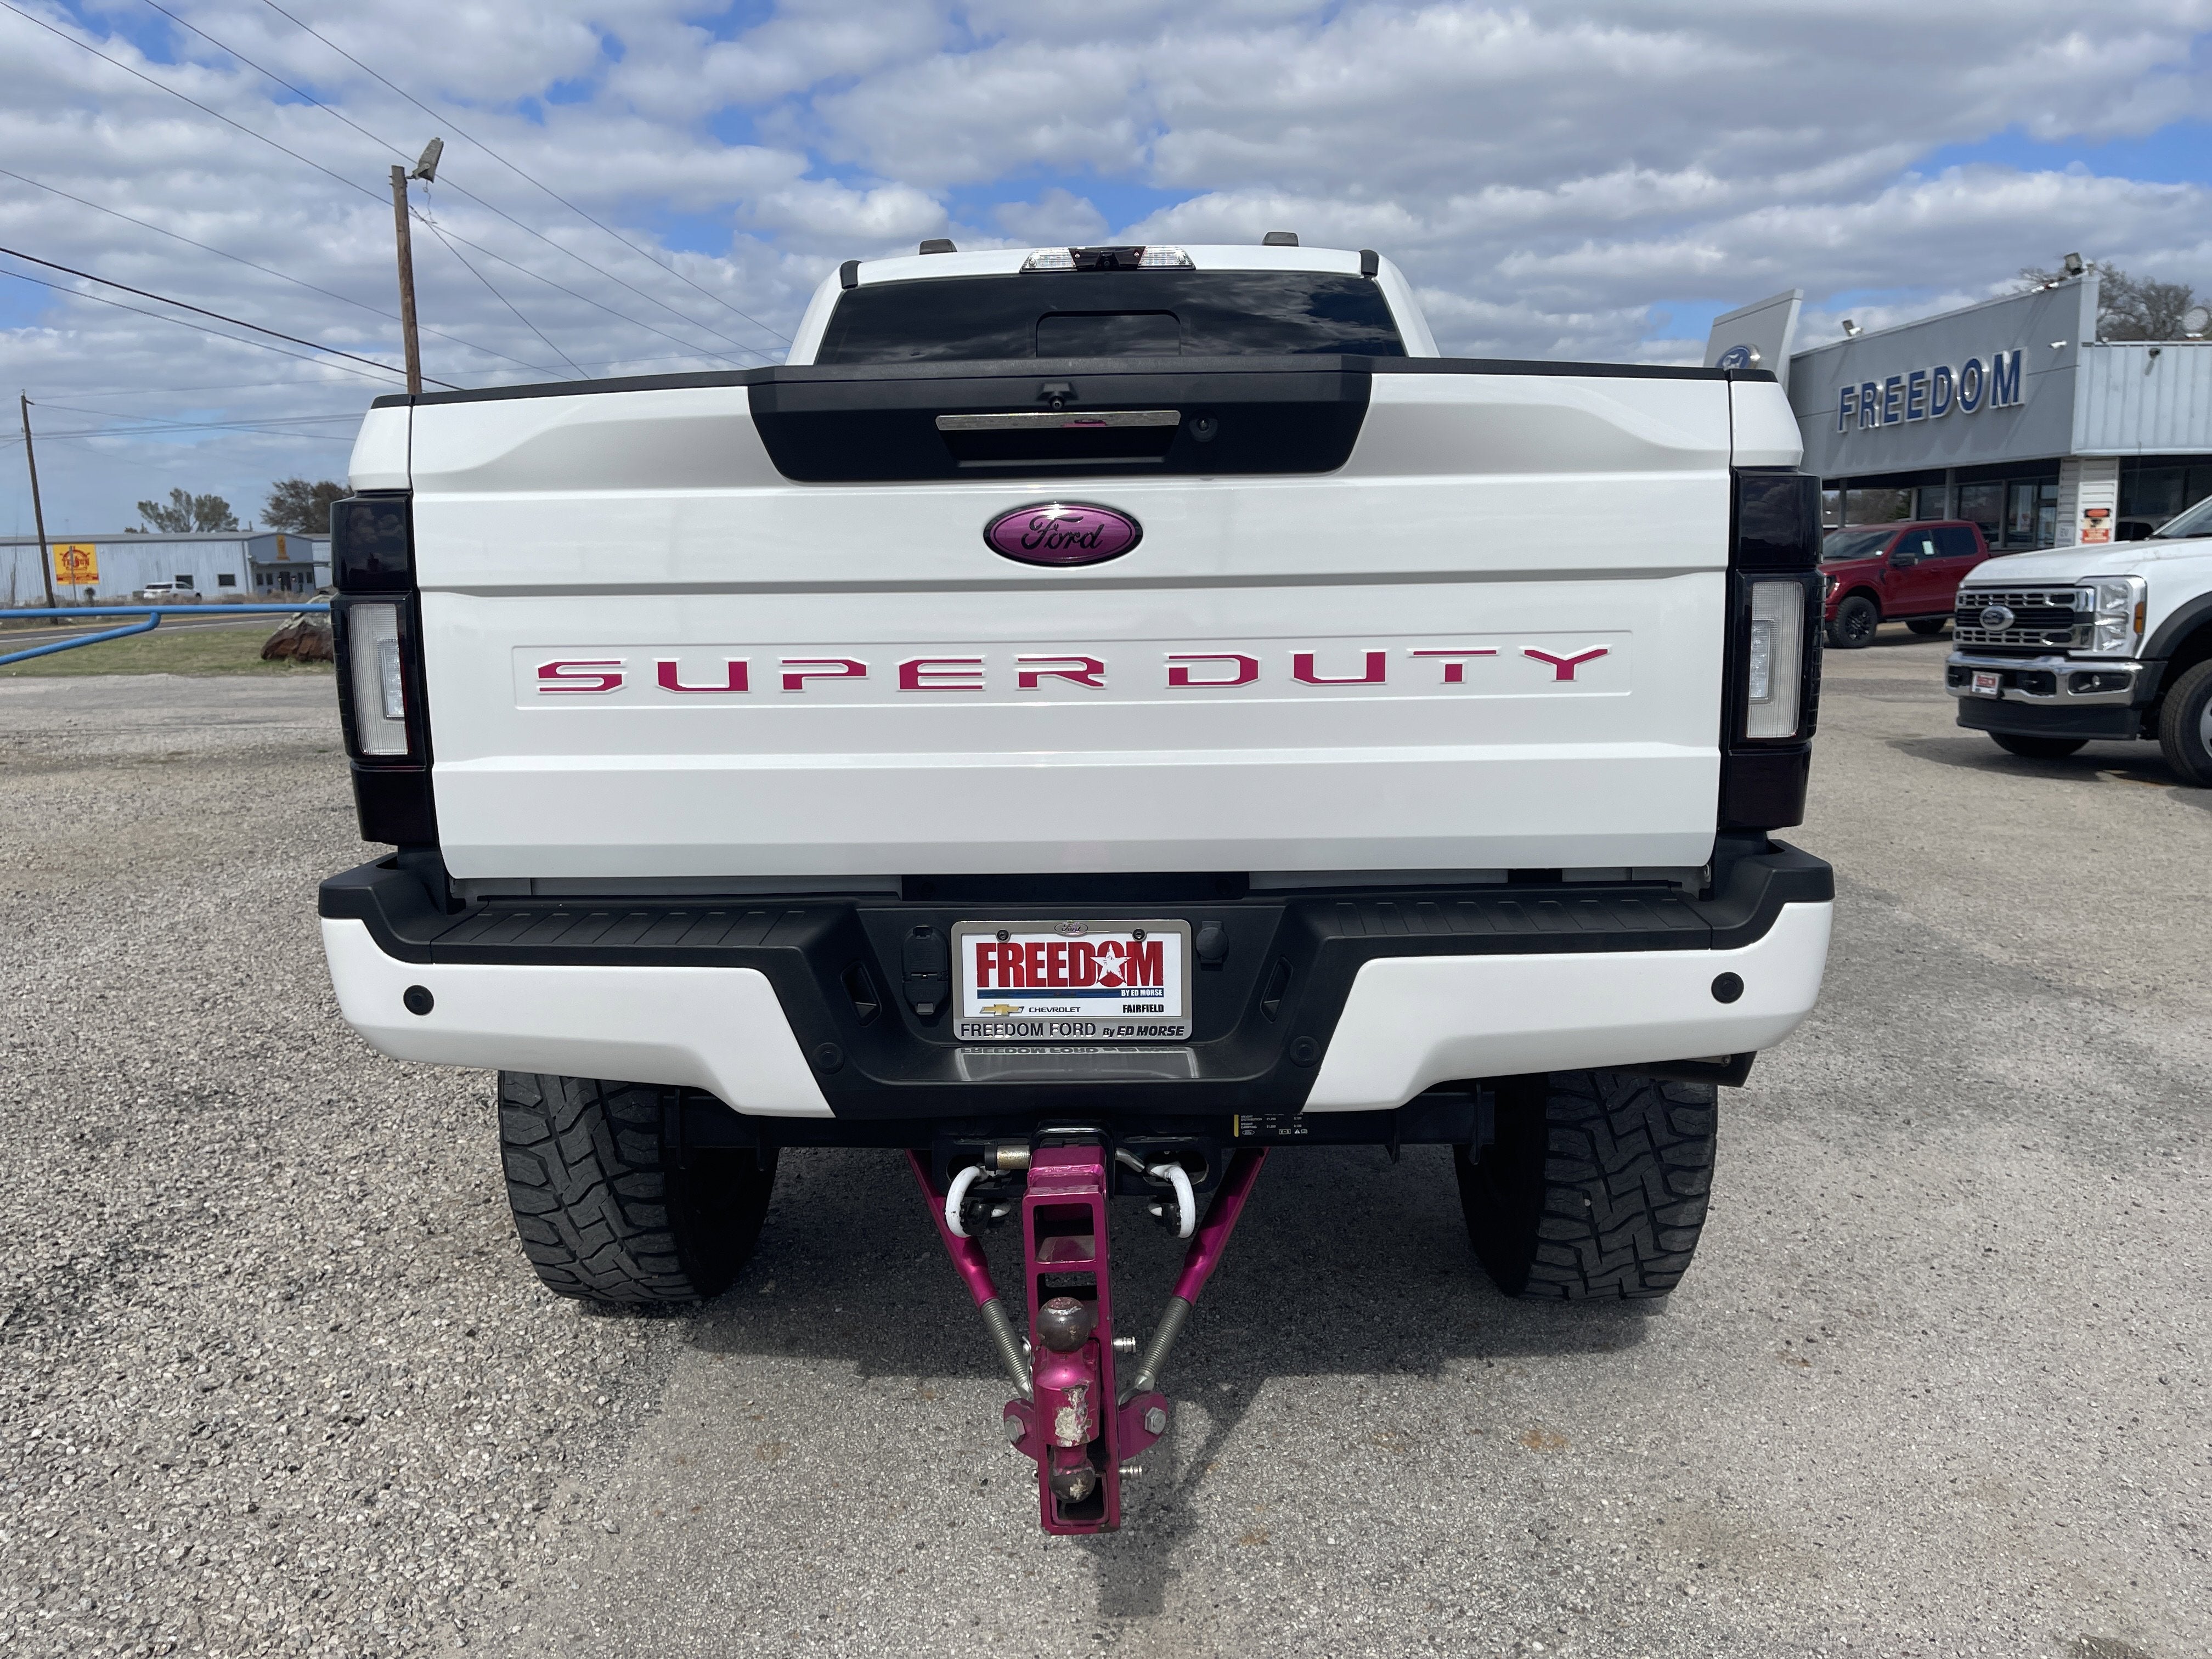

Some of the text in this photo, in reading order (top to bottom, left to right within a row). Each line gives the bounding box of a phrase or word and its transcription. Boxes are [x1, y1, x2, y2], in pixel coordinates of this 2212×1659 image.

[1838, 347, 2027, 432] FREEDOM
[1021, 515, 1105, 549] Ford
[539, 650, 1606, 691] SUPER DUTY
[976, 940, 1164, 988] FREEDOM
[1122, 1004, 1164, 1013] FAIRFIELD
[961, 1023, 1185, 1037] FREEDOM FORD By ED MORSE
